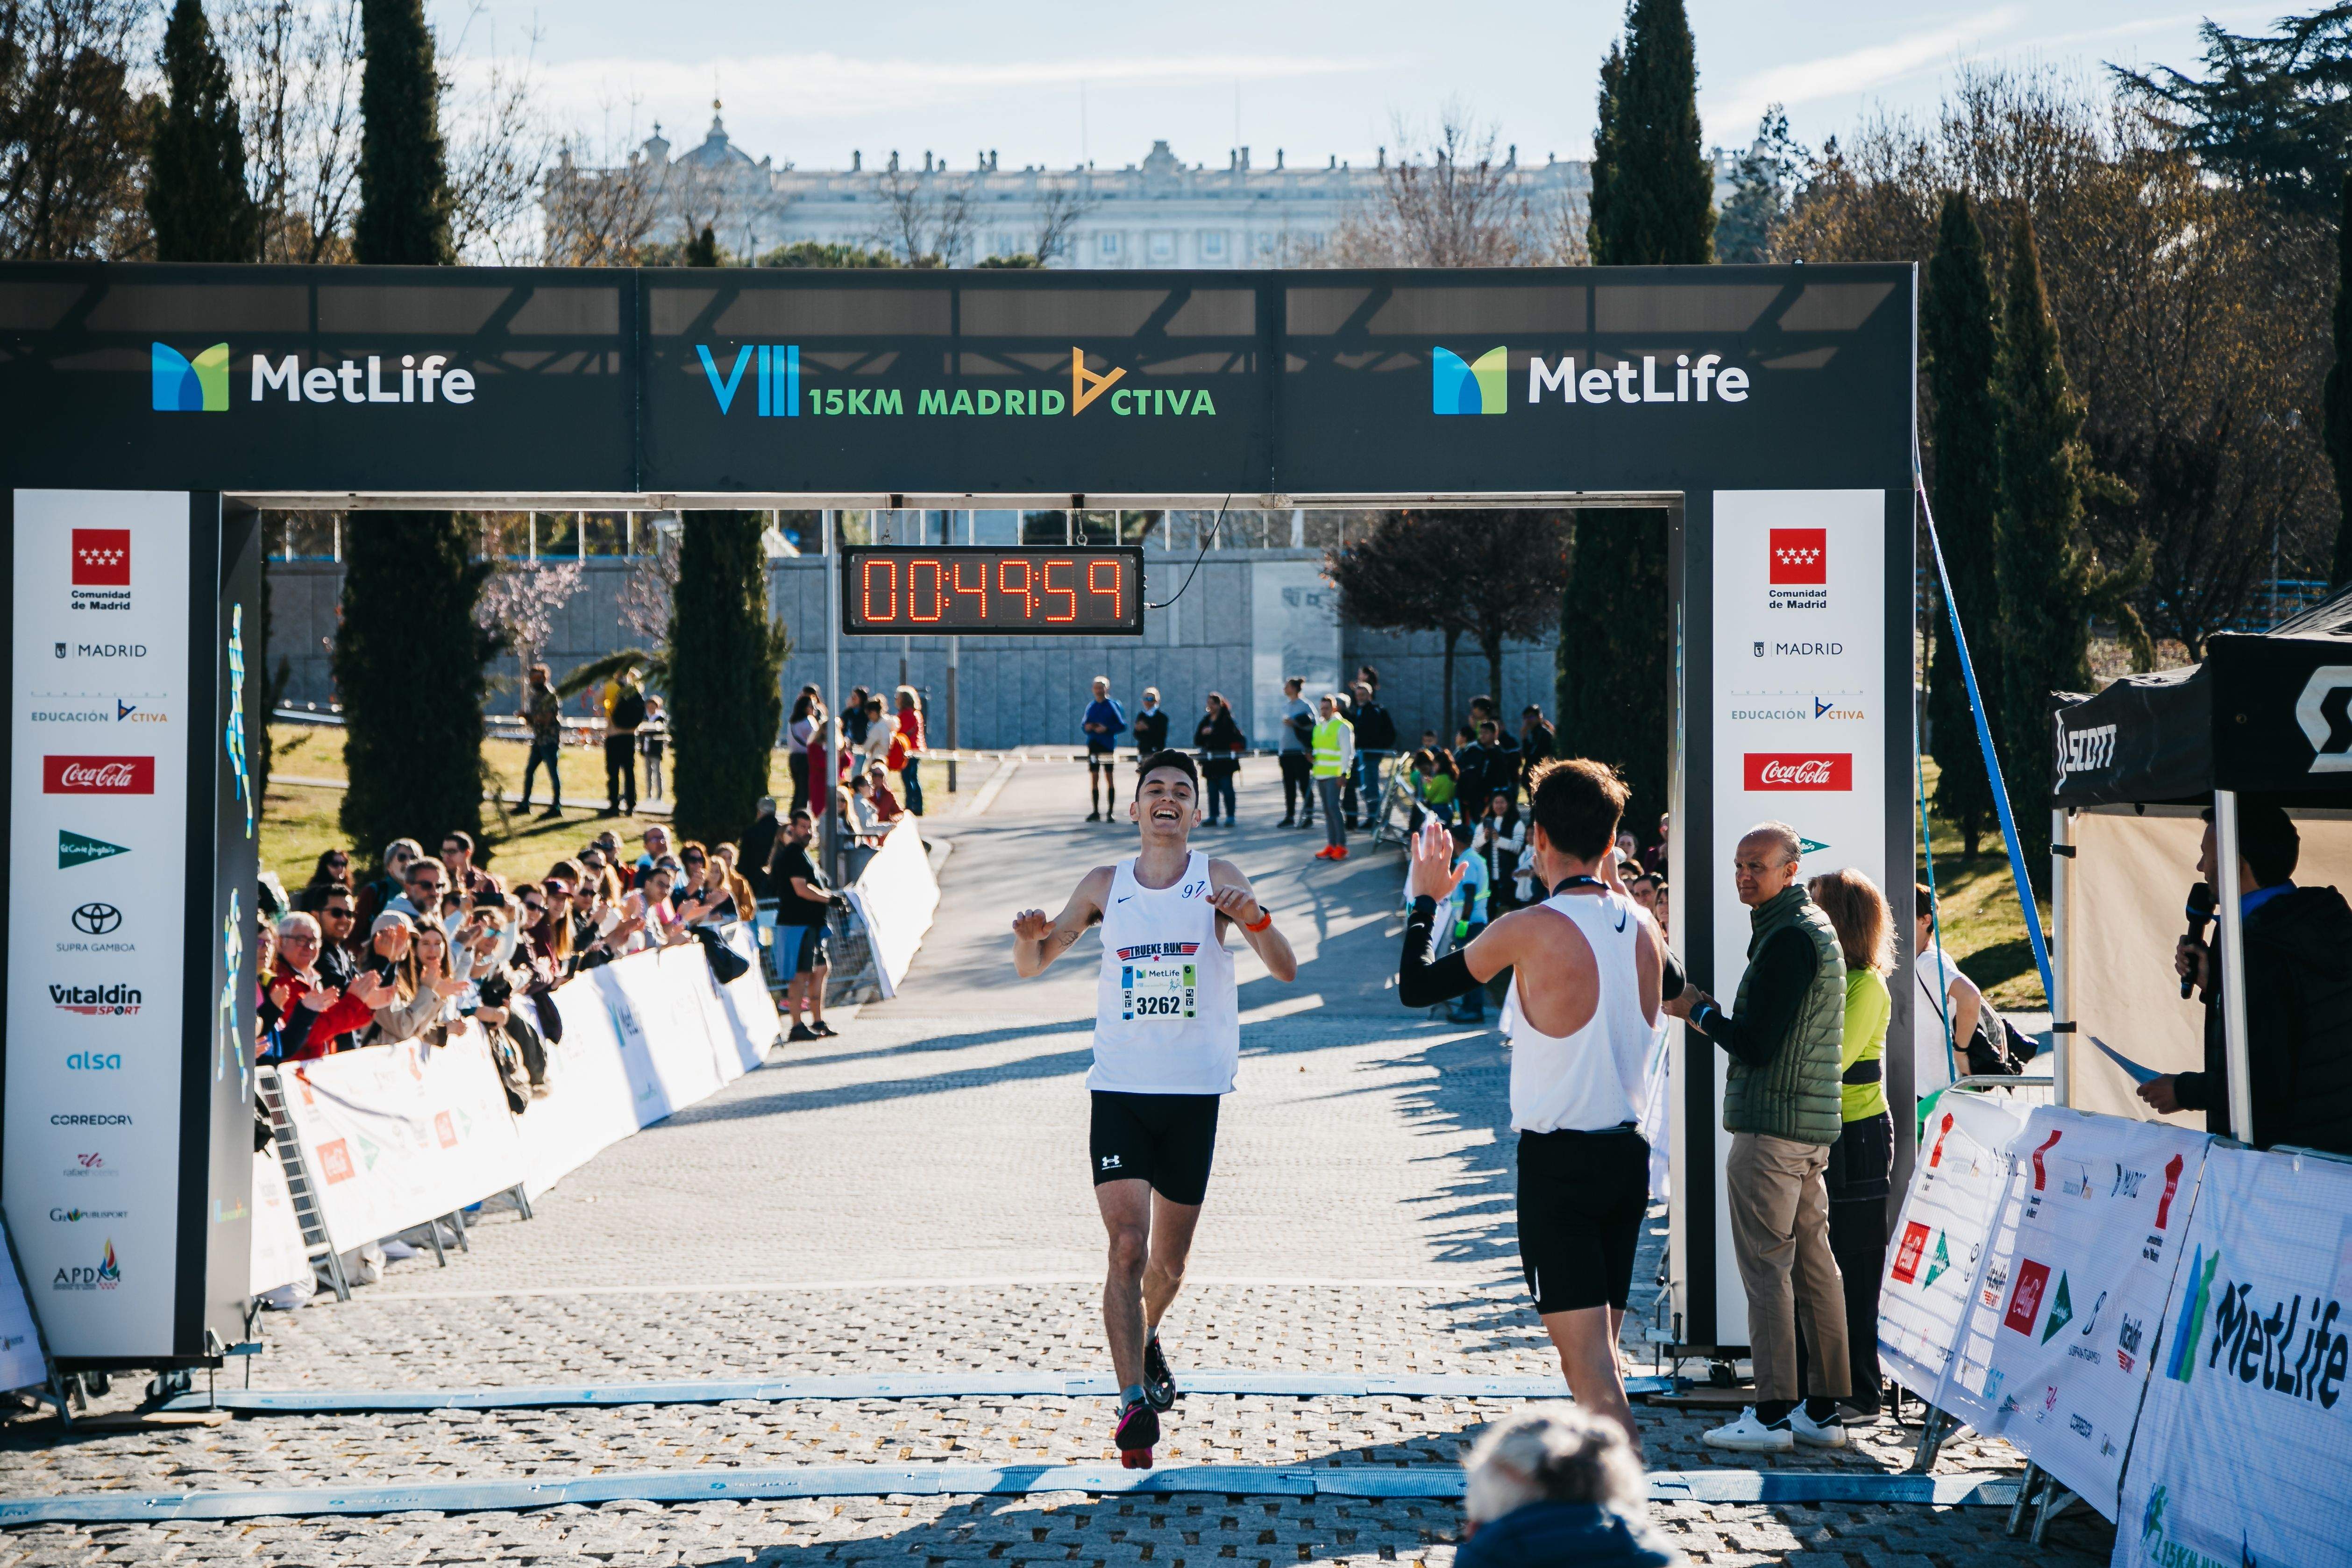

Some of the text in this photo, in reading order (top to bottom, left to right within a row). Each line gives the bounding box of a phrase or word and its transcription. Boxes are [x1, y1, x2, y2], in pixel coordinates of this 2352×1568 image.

[251, 355, 476, 404] MetLife
[696, 345, 799, 417] VIII
[809, 389, 904, 415] 15KM
[917, 389, 1066, 415] MADRID
[1528, 354, 1749, 404] MetLife
[71, 590, 131, 599] Comunidad
[863, 560, 1121, 622] 00:49:59
[71, 601, 131, 610] de Madrid
[1769, 600, 1827, 609] de Madrid
[78, 645, 147, 657] MADRID
[1776, 643, 1843, 655] MADRID
[31, 710, 109, 722] EDUCACIÓN
[1732, 708, 1806, 720] EDUCACIÓN
[2066, 724, 2117, 772] SCOTT
[61, 763, 136, 787] Coca-Cola
[1761, 760, 1834, 784] Coca-Cola
[56, 943, 135, 952] SUPRA GAMBOA
[1130, 942, 1182, 957] TRUEKE RUN
[49, 983, 142, 1004] Vitaldin
[97, 1006, 141, 1015] SPORT
[1137, 996, 1180, 1015] 3262
[66, 1050, 122, 1070] alsa
[2209, 1279, 2348, 1410] MetLife
